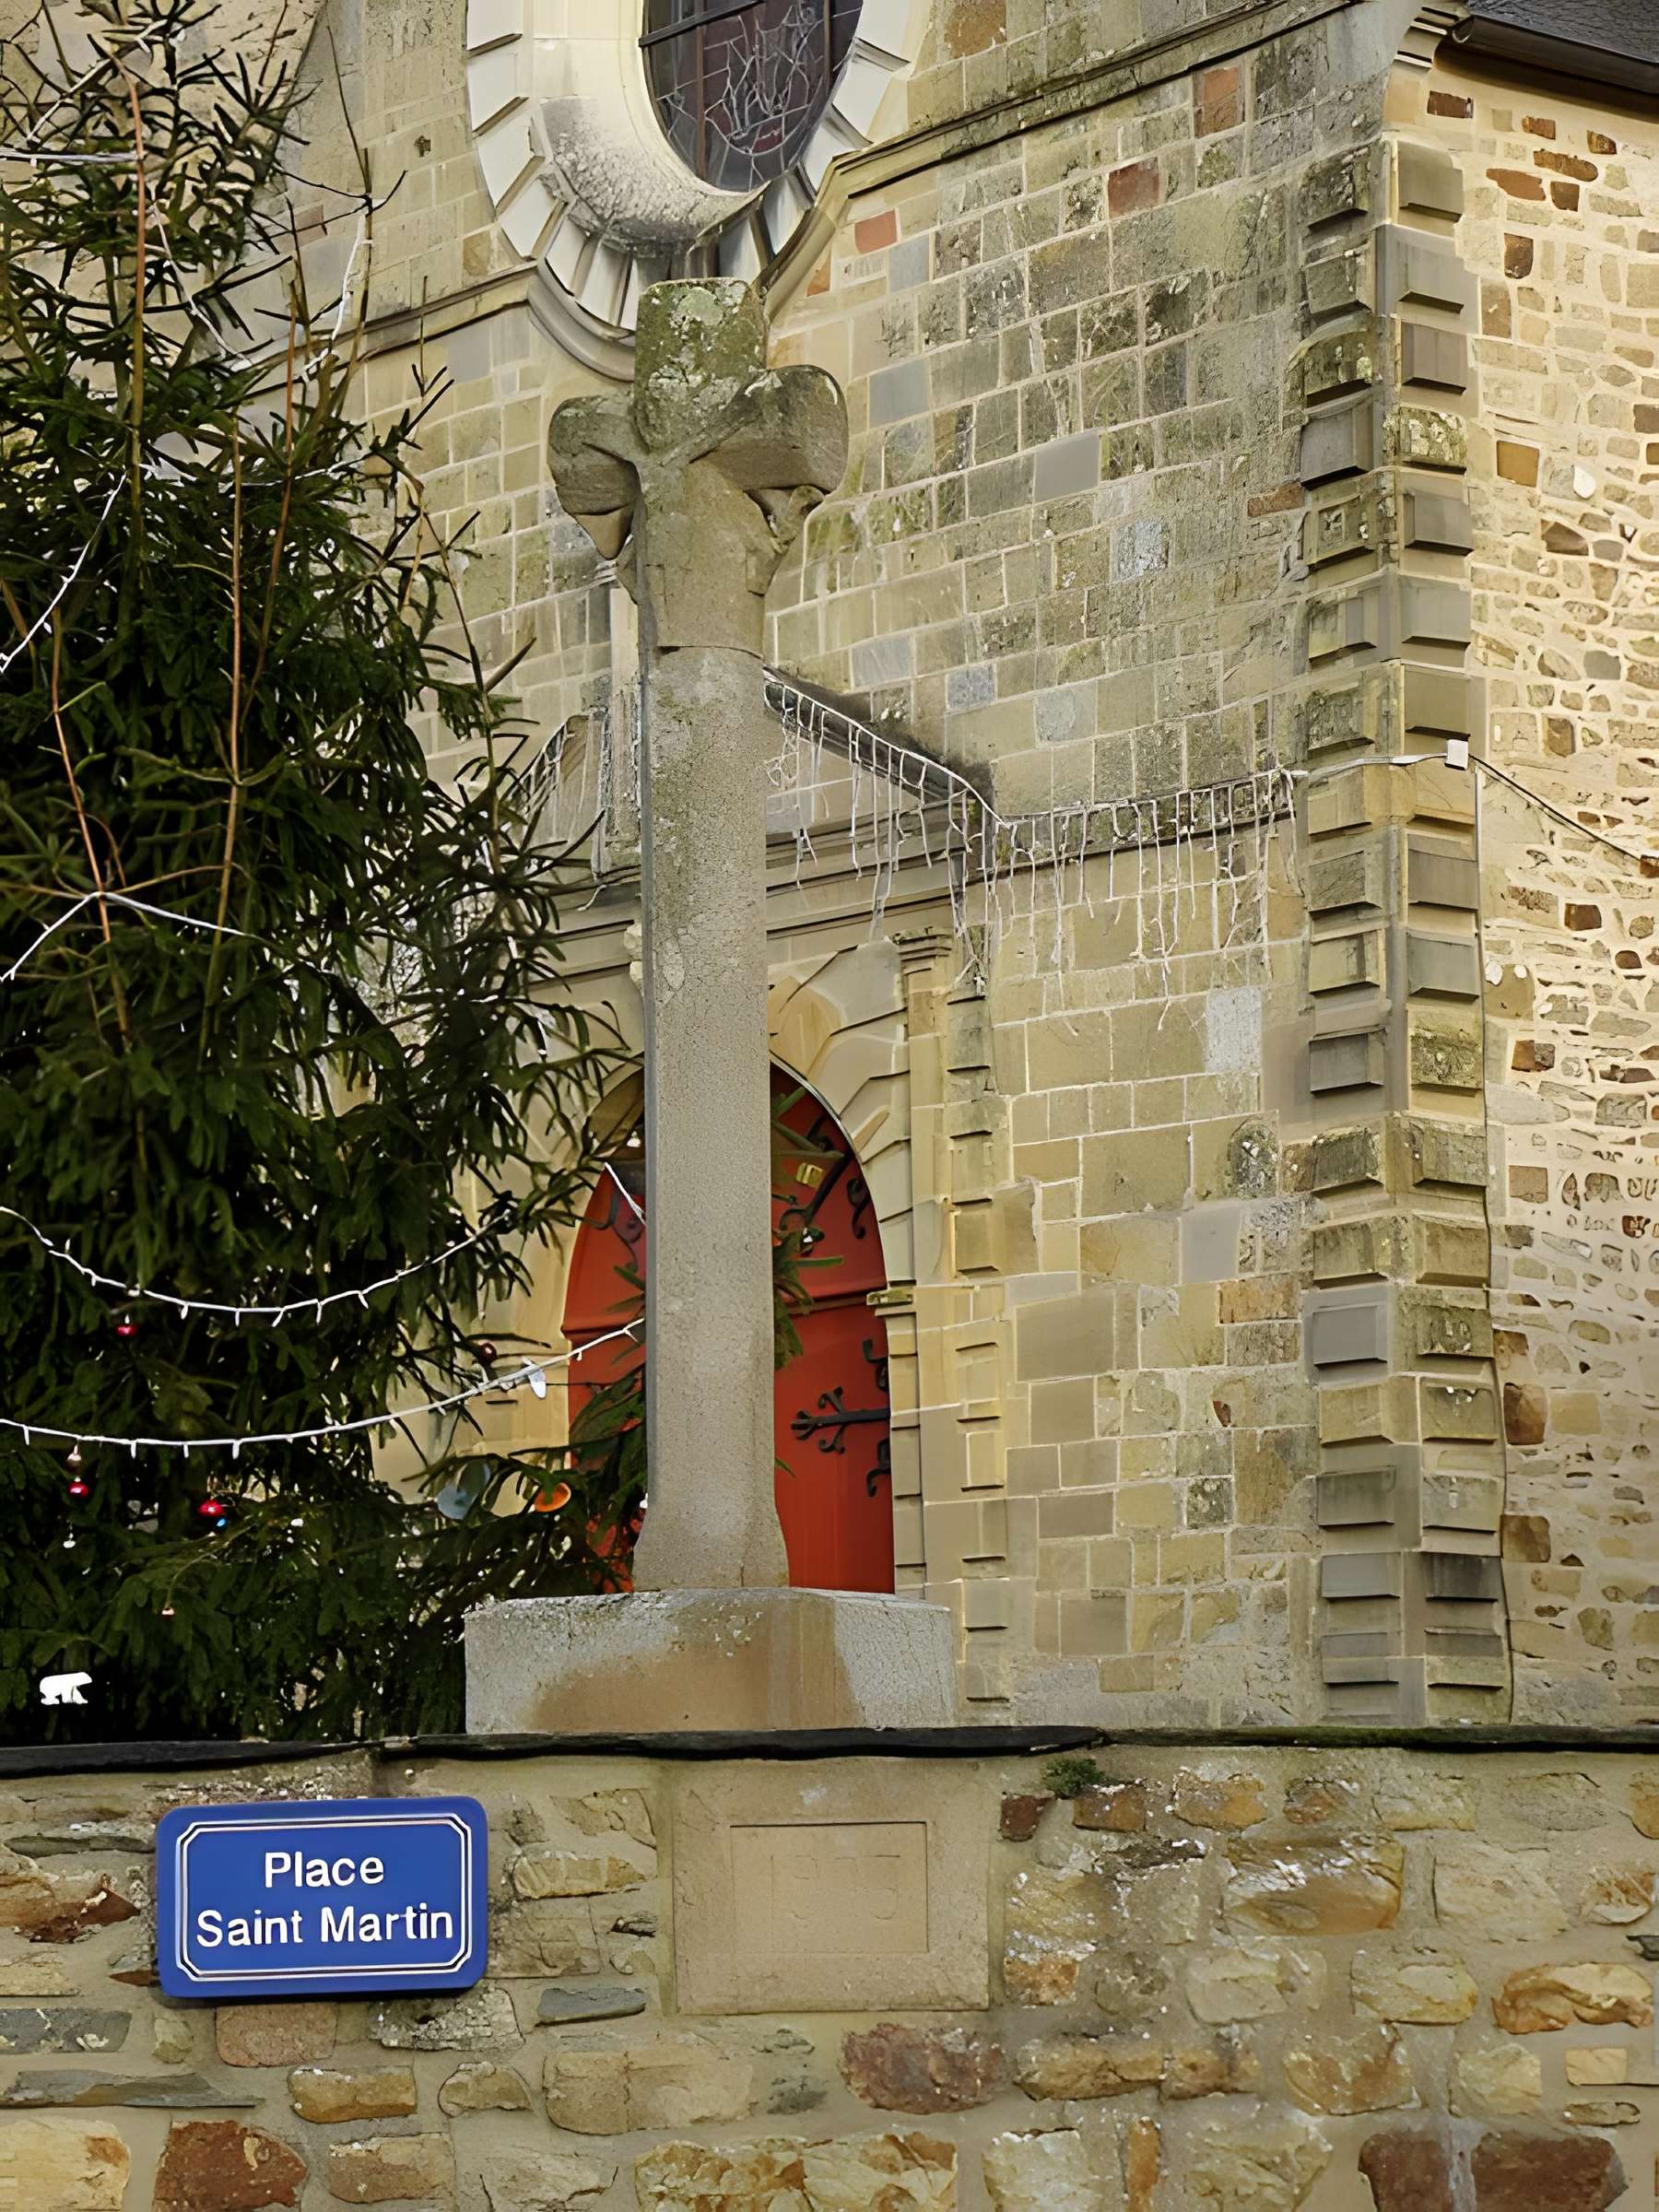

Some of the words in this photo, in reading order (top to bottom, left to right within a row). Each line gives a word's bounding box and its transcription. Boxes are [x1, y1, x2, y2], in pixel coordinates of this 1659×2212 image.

[265, 1852, 384, 1888] Place
[196, 1910, 303, 1947] Saint
[321, 1902, 453, 1943] Martin
